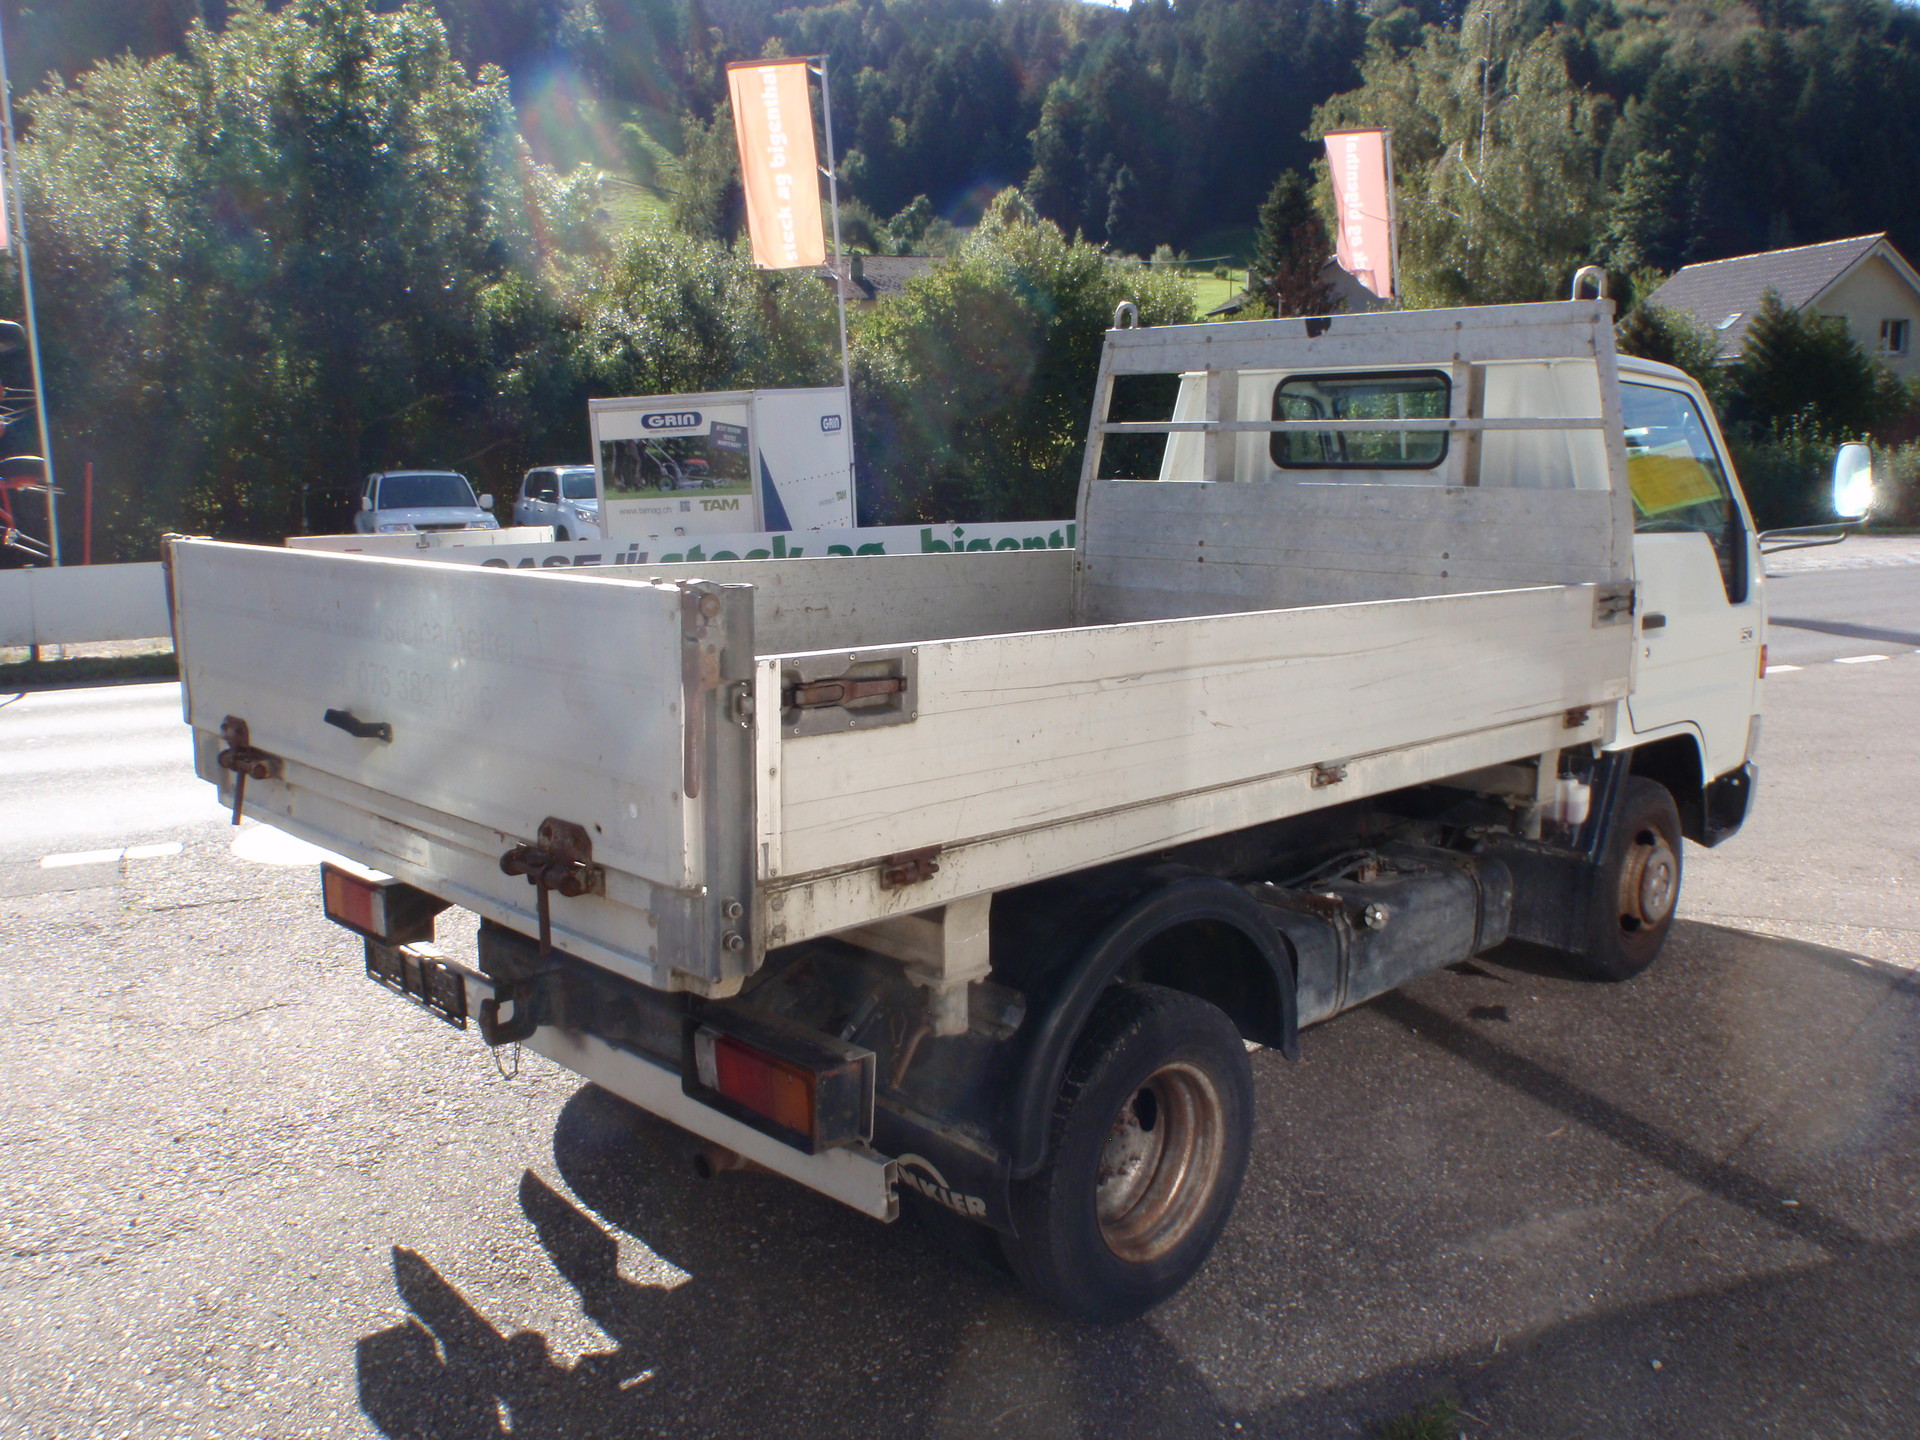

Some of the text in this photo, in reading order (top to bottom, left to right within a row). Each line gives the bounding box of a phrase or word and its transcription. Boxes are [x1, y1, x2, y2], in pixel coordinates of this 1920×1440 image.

[757, 67, 799, 262] steck ag bigenthal
[648, 413, 696, 428] GRIN
[699, 498, 740, 512] TAM
